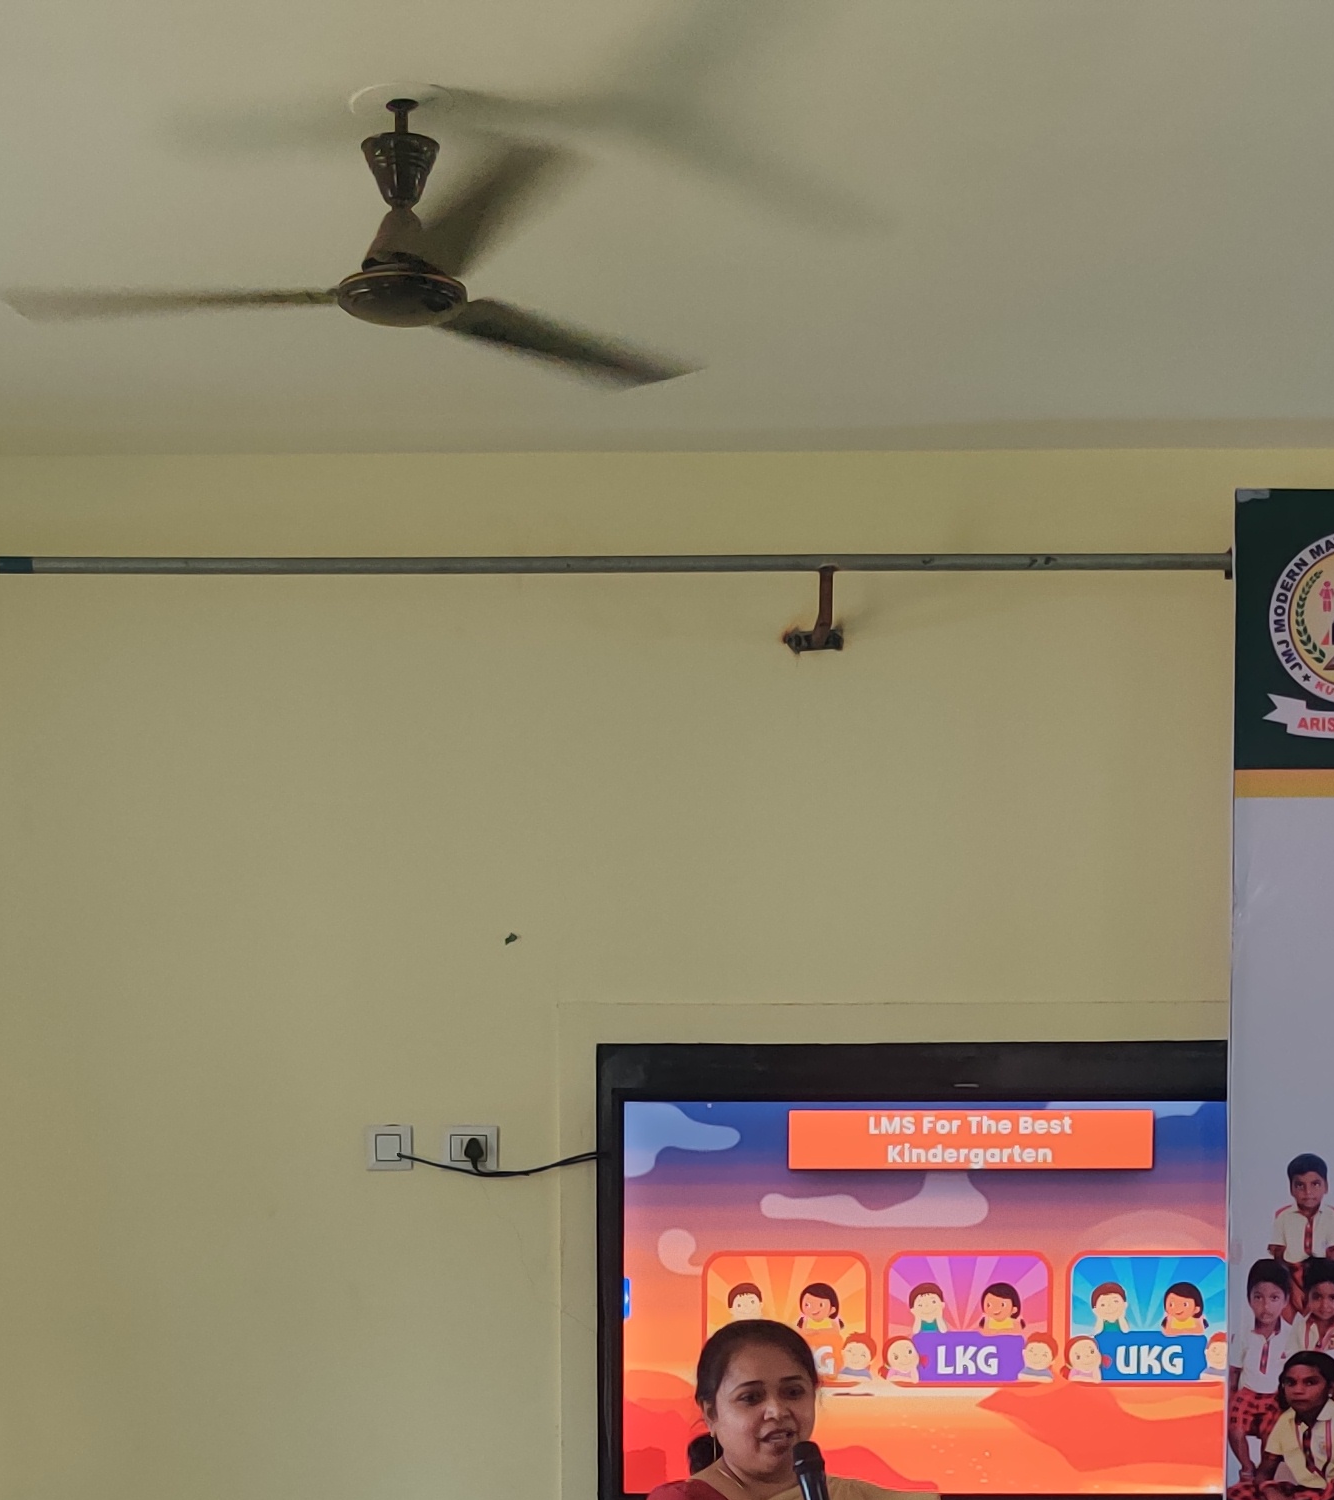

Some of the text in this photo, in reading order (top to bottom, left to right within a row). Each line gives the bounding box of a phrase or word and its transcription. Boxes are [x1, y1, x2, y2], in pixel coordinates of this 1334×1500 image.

[1273, 557, 1309, 633] MODERN
[1276, 639, 1303, 672] JMJ
[869, 1115, 1073, 1135] LMS For The Best
[887, 1143, 1053, 1169] Kindergarten
[936, 1344, 999, 1375] LKG
[1116, 1344, 1184, 1375] UKG
